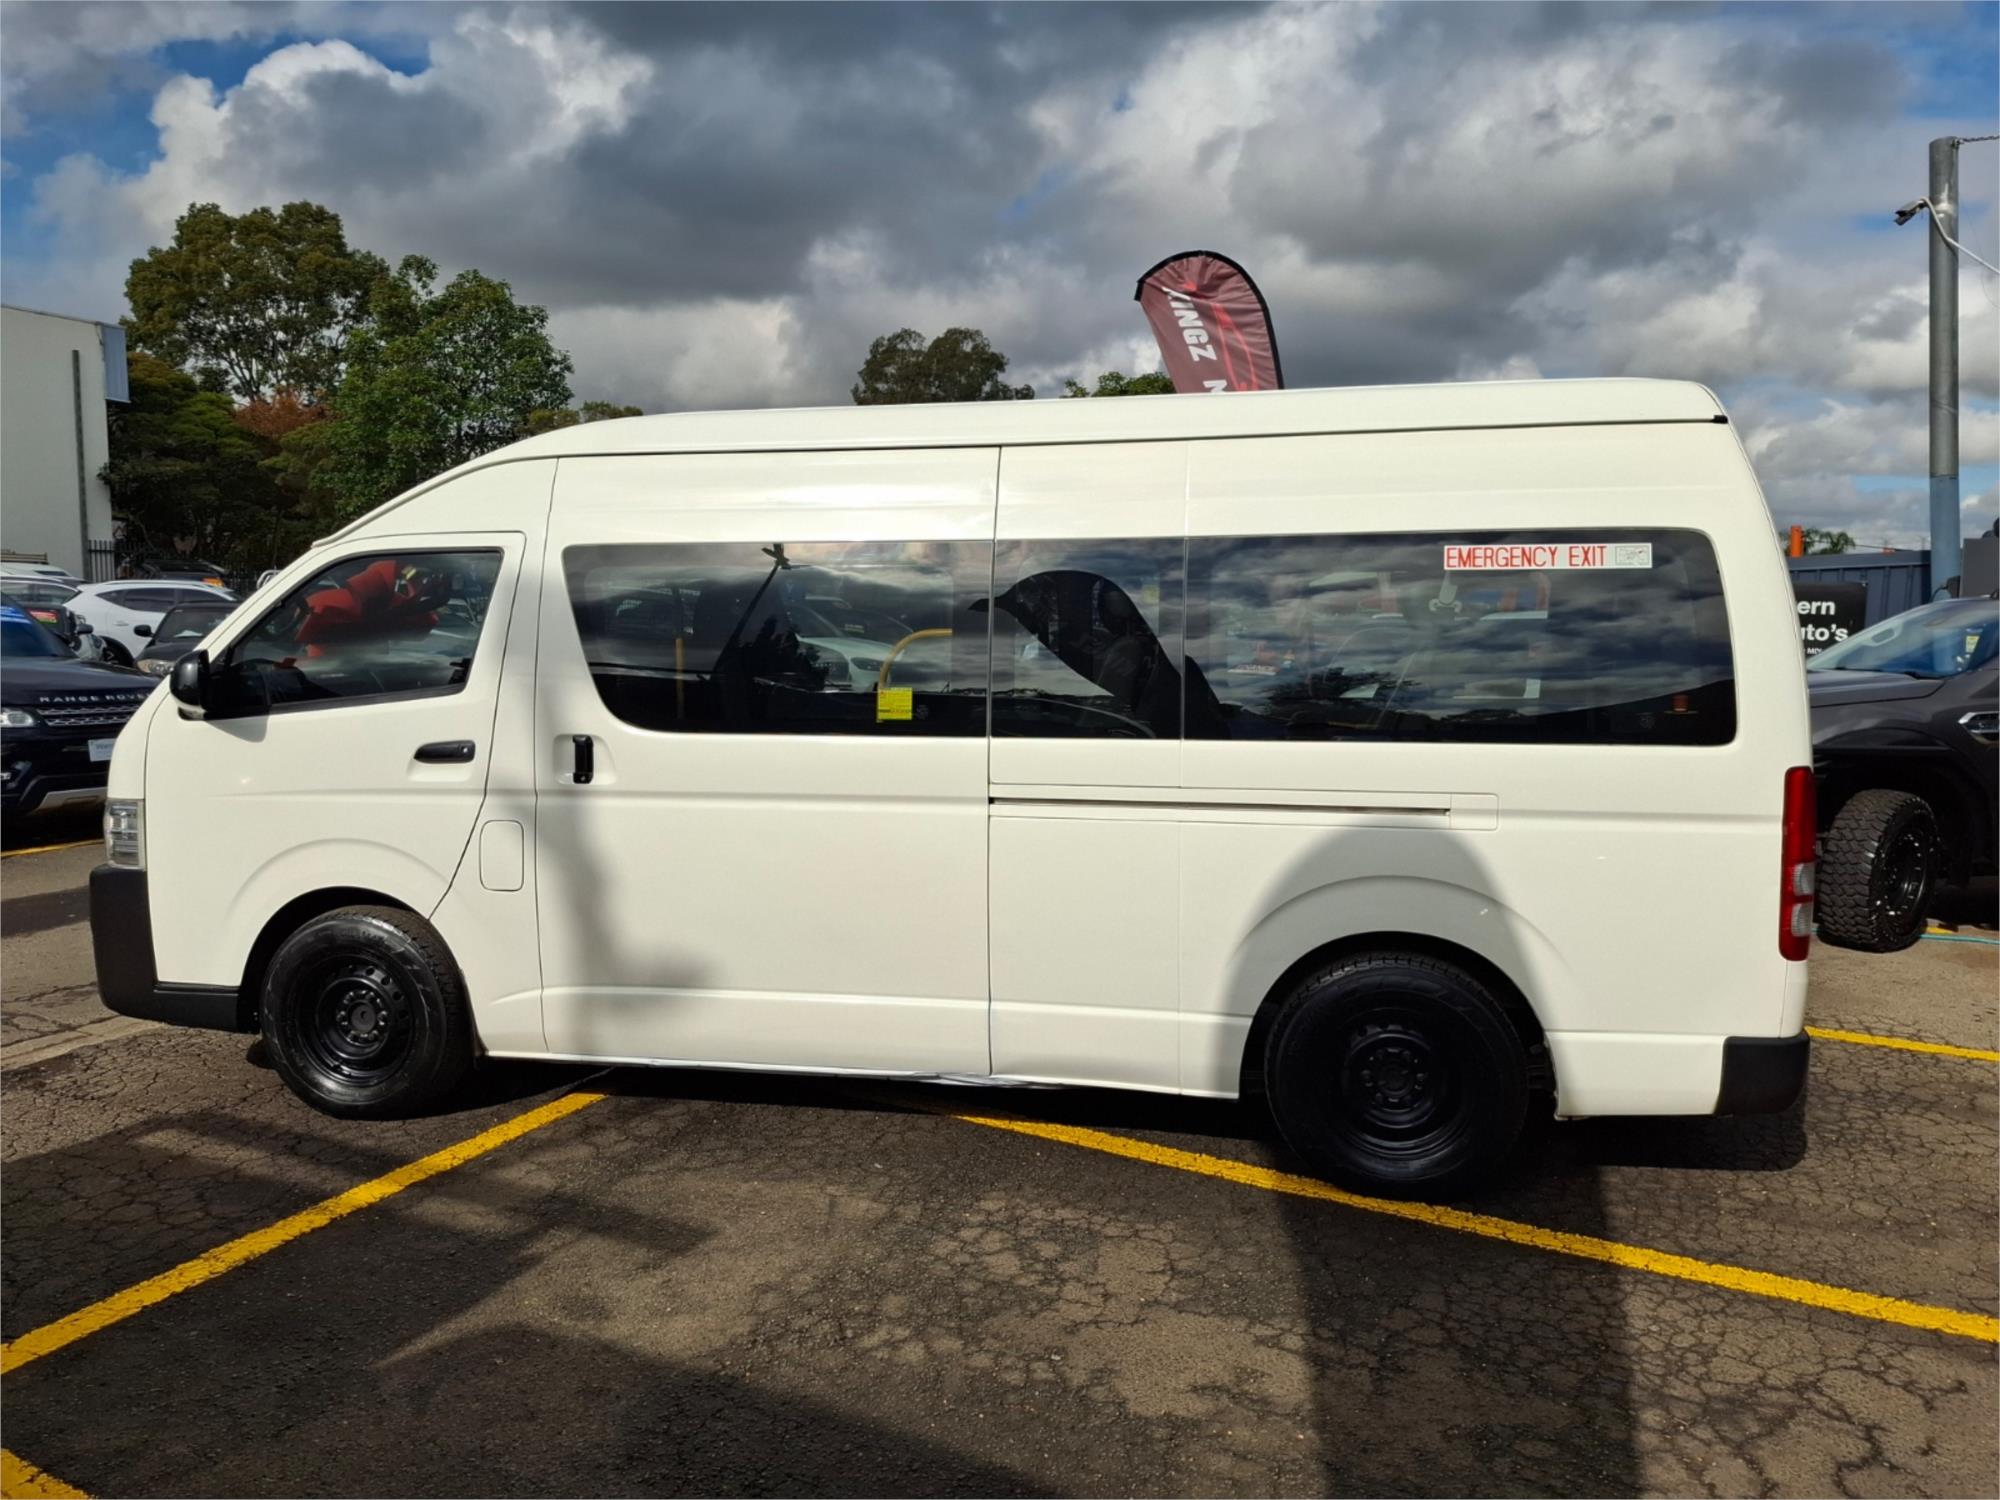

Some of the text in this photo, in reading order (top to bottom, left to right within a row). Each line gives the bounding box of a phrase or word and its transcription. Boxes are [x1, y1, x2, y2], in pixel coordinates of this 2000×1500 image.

[1446, 546, 1607, 568] EMERGENCY EXIT
[1797, 600, 1836, 615] ern
